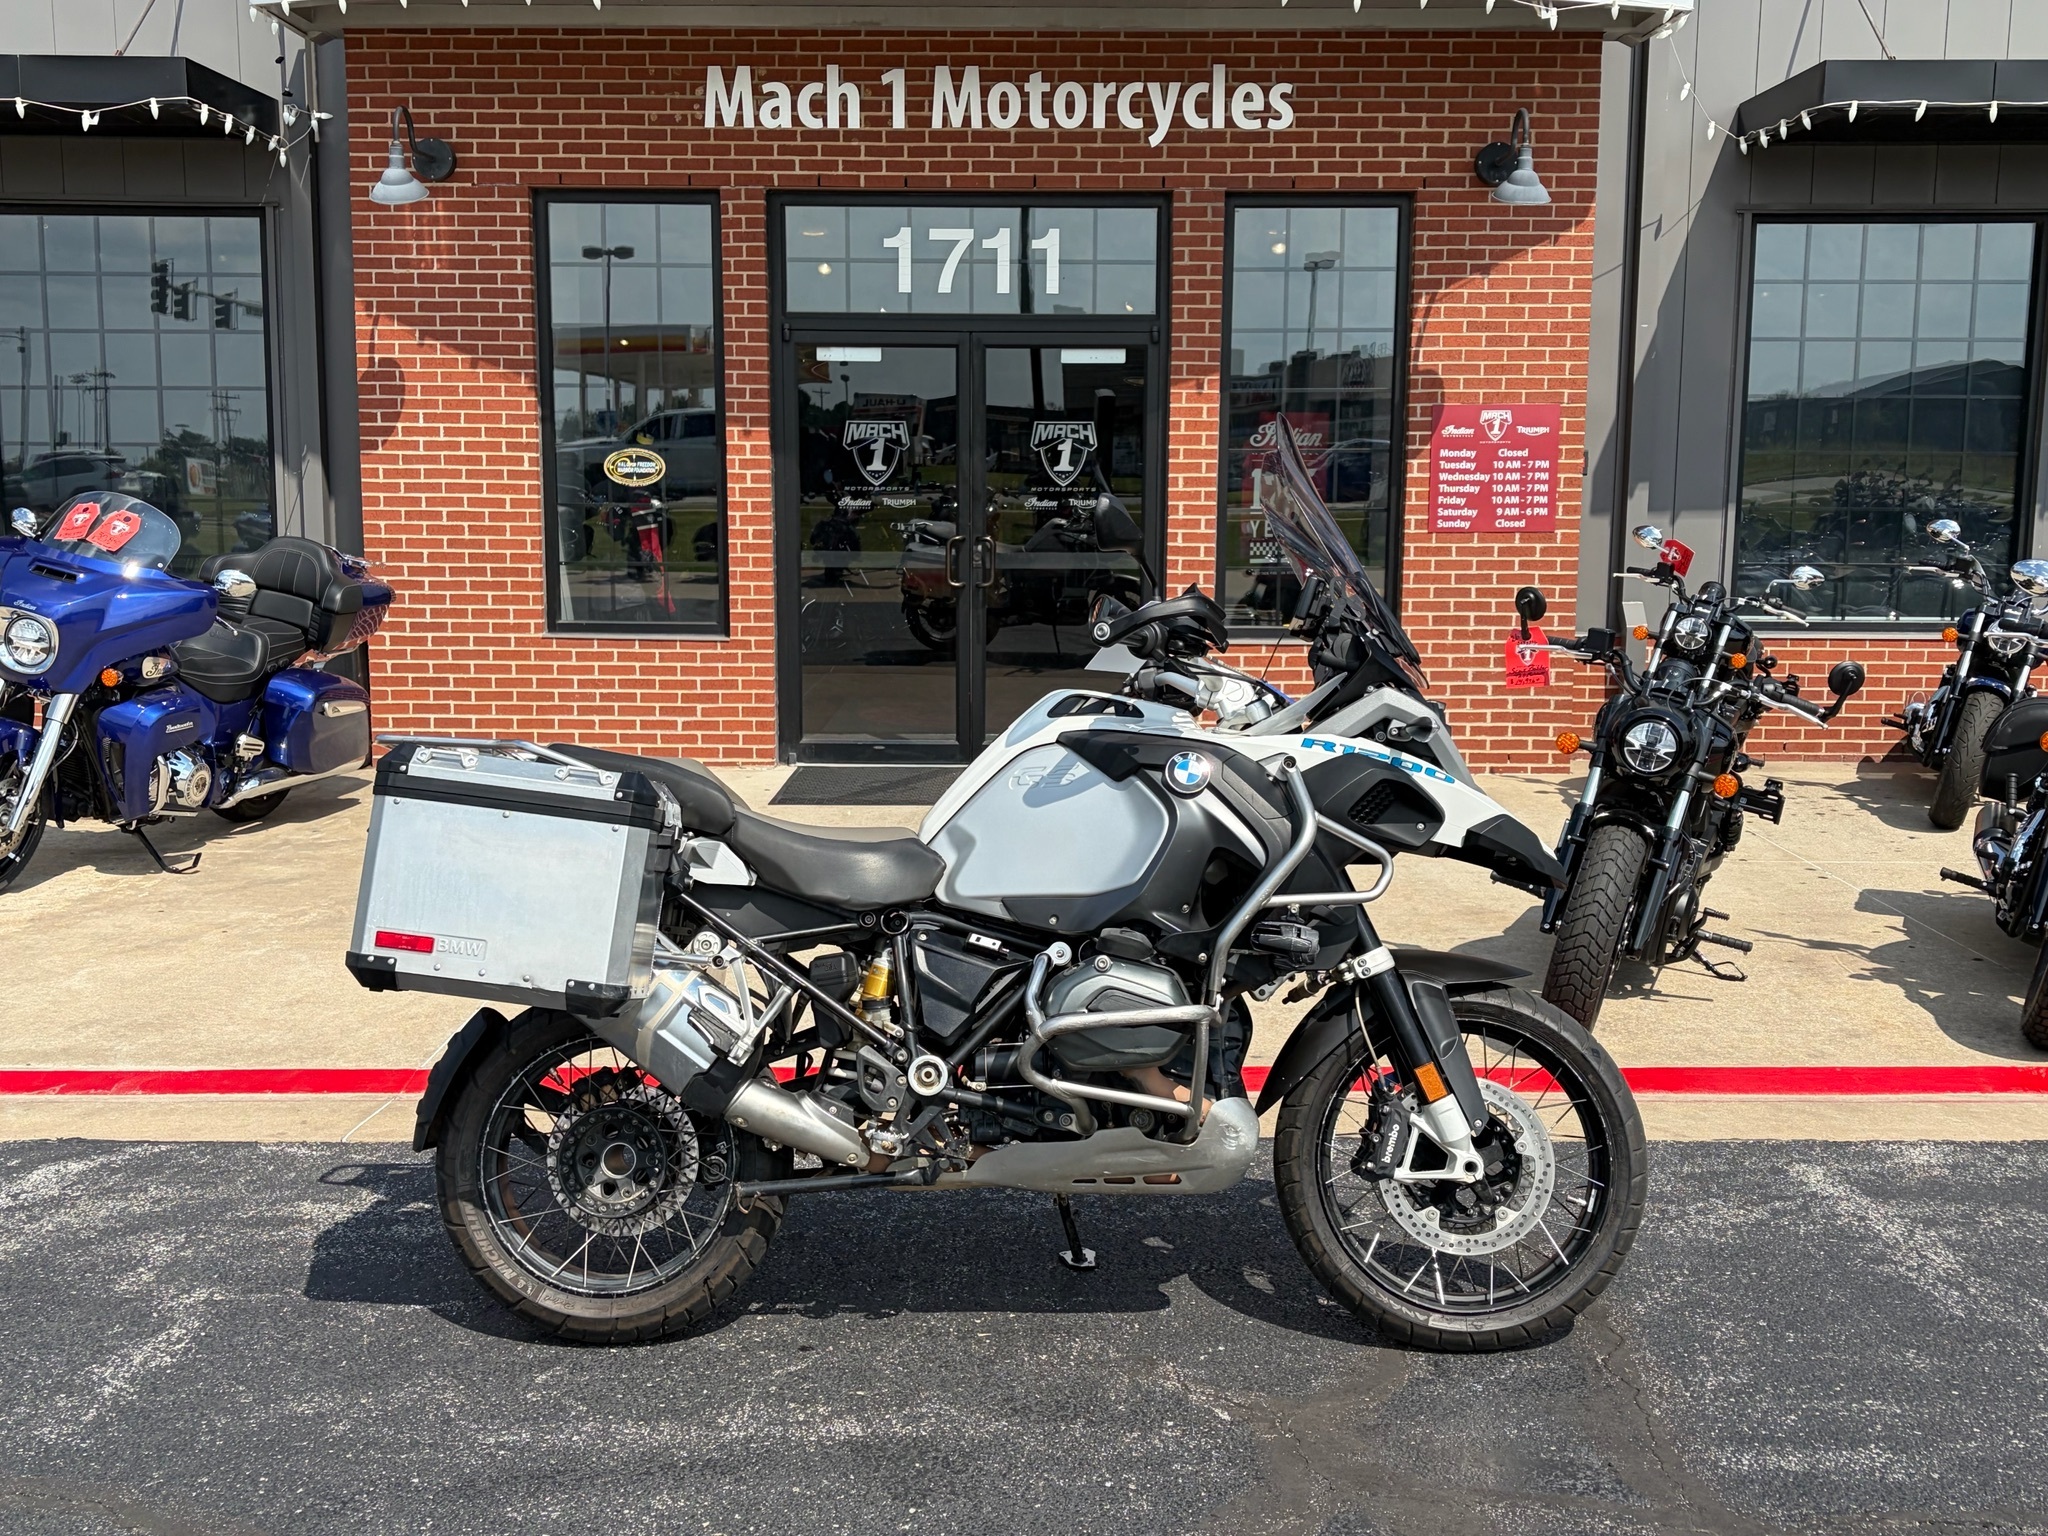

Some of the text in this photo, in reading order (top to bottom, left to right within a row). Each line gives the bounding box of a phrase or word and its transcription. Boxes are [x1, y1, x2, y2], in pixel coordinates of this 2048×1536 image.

[704, 64, 1295, 148] Mach 1 Motorcycles
[882, 227, 1060, 294] 1711
[1482, 411, 1510, 422] MACH
[846, 423, 908, 445] MACH
[1033, 423, 1095, 446] MACH
[1441, 424, 1475, 435] Indian
[1516, 425, 1550, 436] TRIUMPH
[866, 437, 888, 471] 1
[1053, 437, 1075, 472] 1
[1439, 448, 1529, 459] Monday Closed
[1439, 460, 1476, 471] Tuesday
[1493, 460, 1504, 469] 10
[1505, 460, 1521, 469] AM
[1527, 460, 1534, 469] 7
[1535, 460, 1550, 469] PM
[1439, 472, 1491, 482] Wednesday
[1492, 472, 1504, 481] 10
[1505, 472, 1520, 481] AM
[1527, 472, 1533, 481] 7
[1534, 472, 1549, 481] PM
[1438, 484, 1480, 494] Thursday
[1492, 484, 1503, 492] 10
[1504, 484, 1520, 492] AM
[1526, 484, 1533, 492] 7
[1534, 484, 1549, 492] PM
[837, 496, 873, 507] Indian
[881, 498, 917, 509] TRIUMPH
[1024, 496, 1059, 507] Indian
[1068, 498, 1098, 509] TRIUMP
[1437, 496, 1467, 506] Friday
[1491, 496, 1503, 504] 10
[1503, 496, 1519, 504] AM
[1526, 496, 1532, 504] 7
[1533, 496, 1548, 504] PM
[1437, 507, 1478, 518] Saturday
[1496, 507, 1502, 516] 9
[1503, 507, 1519, 516] AM
[1526, 507, 1532, 516] 6
[1533, 507, 1548, 516] PM
[1437, 519, 1526, 529] Sunday Closed
[1301, 738, 1456, 784] R1200
[437, 938, 483, 957] BMW
[1381, 1123, 1400, 1164] brembo
[460, 1200, 518, 1281] MICHELIN
